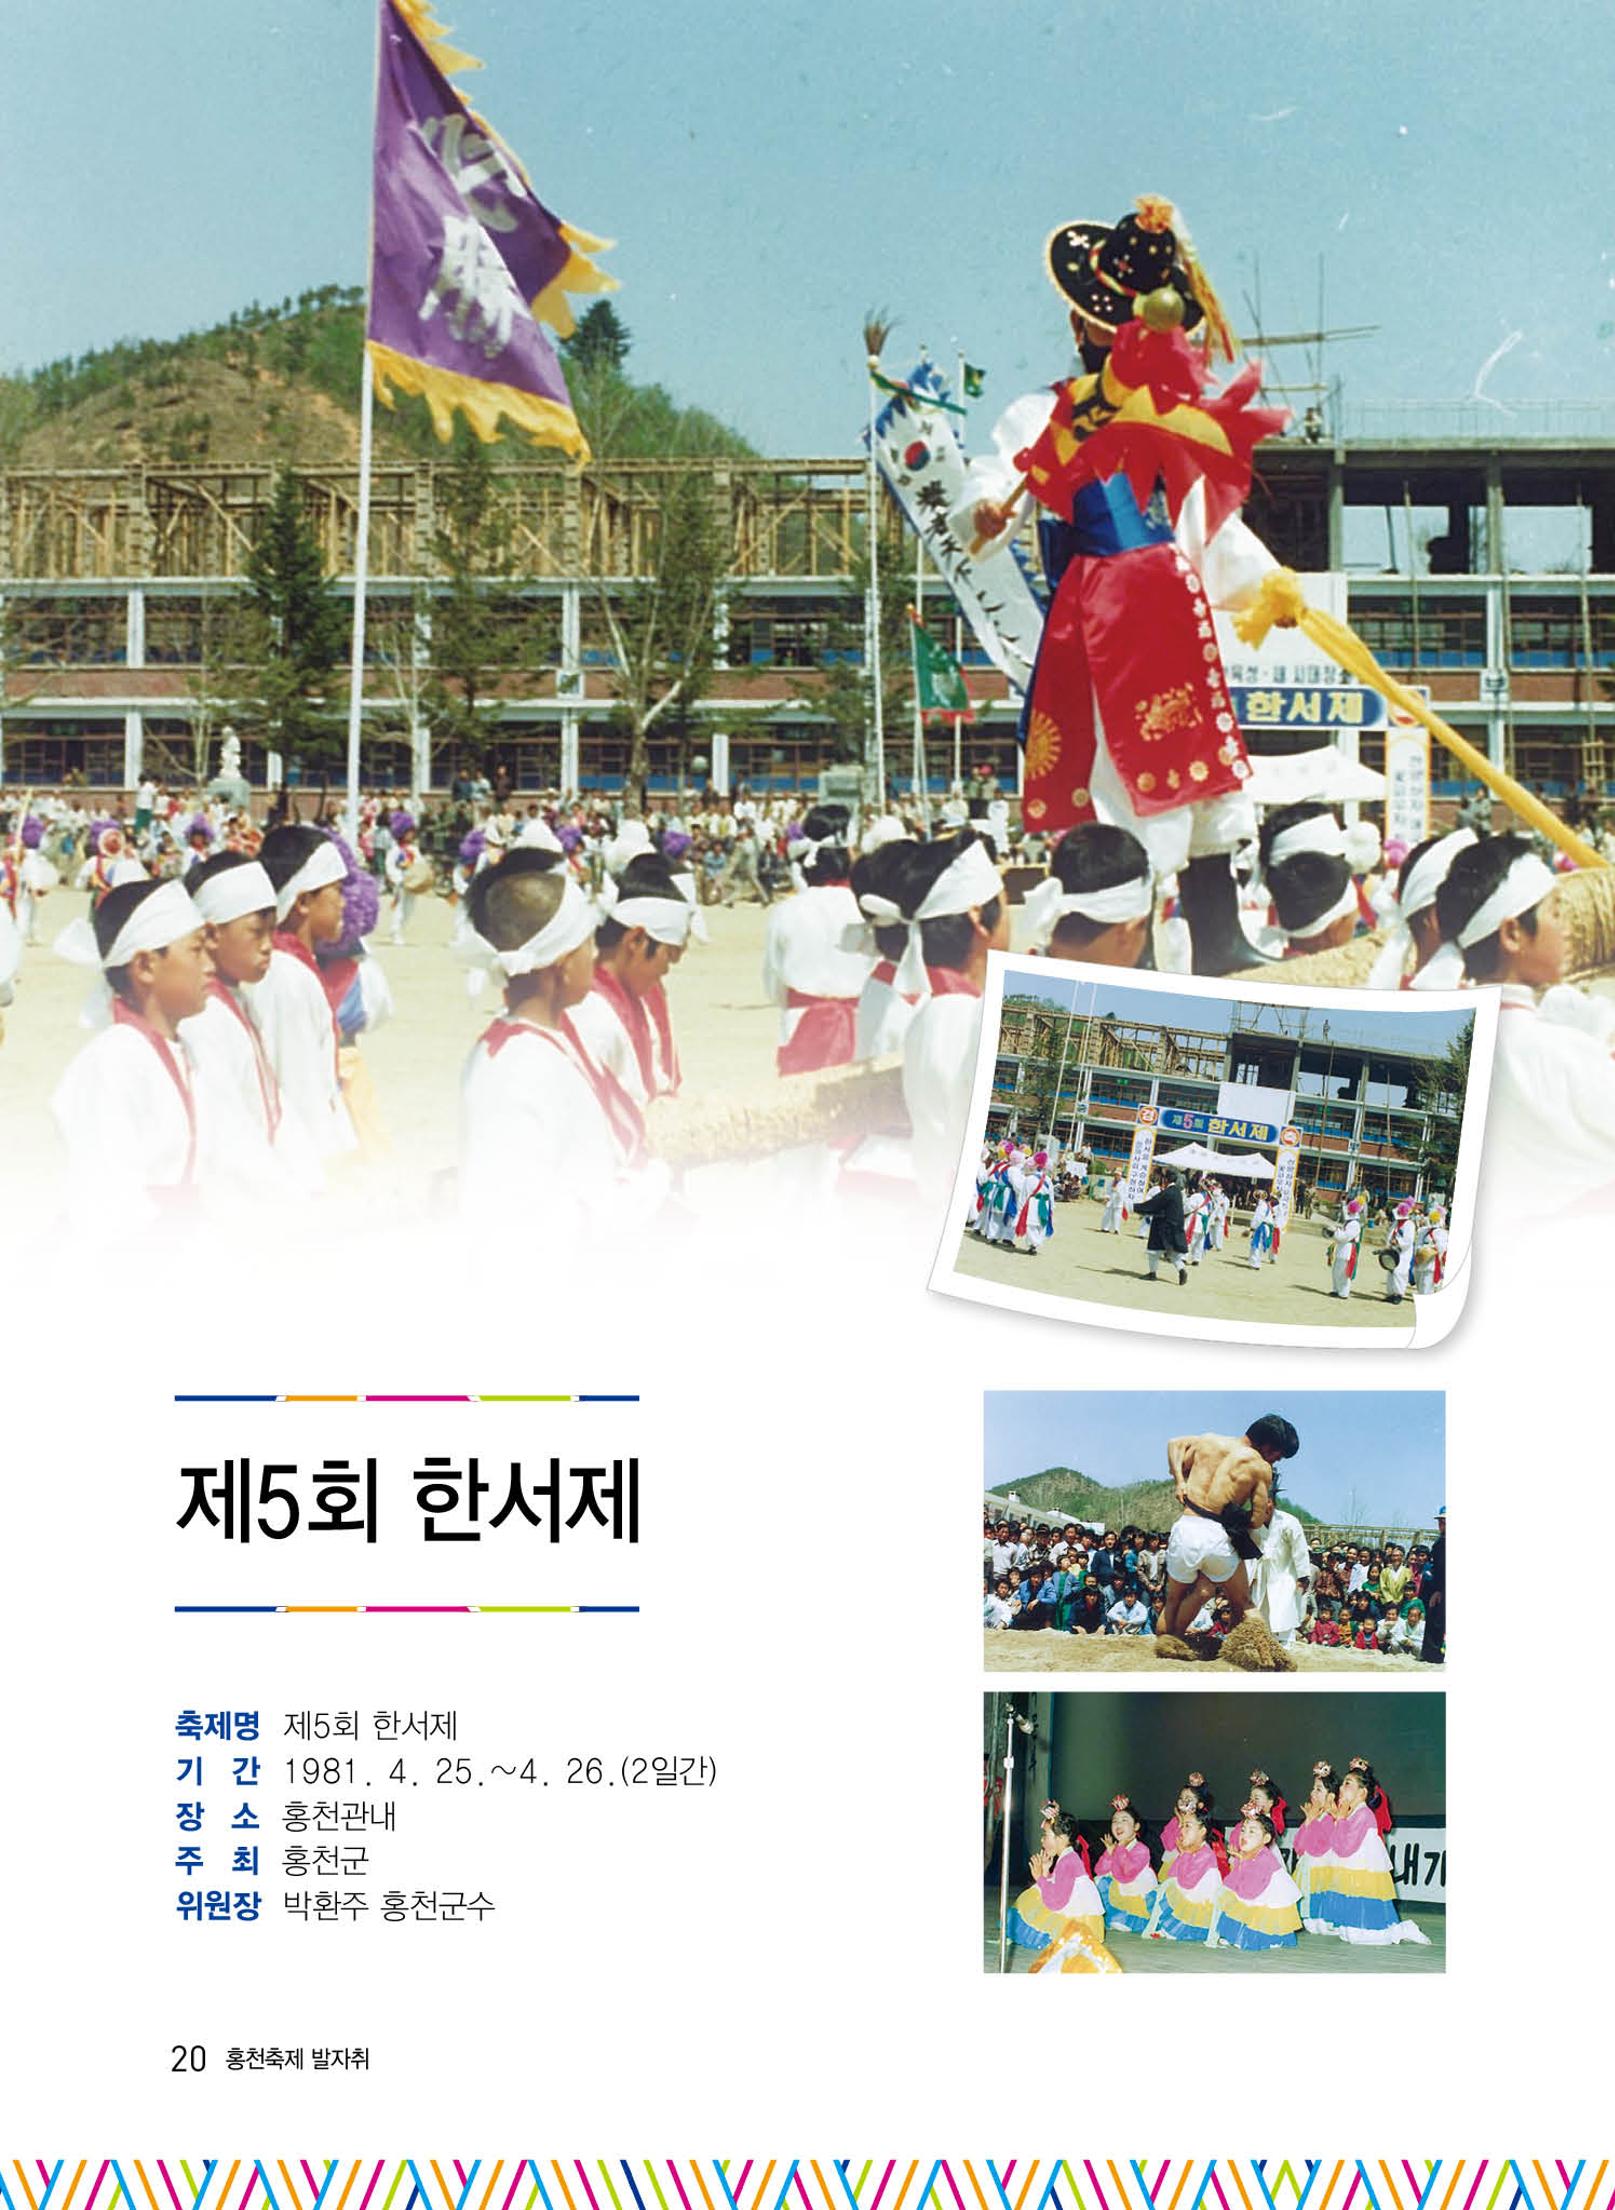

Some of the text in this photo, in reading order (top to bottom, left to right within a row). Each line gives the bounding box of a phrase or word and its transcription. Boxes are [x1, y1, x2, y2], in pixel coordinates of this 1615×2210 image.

[1246, 690, 1364, 724] 한서제
[1172, 1112, 1269, 1141] 제5회 한서제
[175, 1456, 640, 1544] 제5회 한서제
[175, 1709, 457, 1742] 축제명 제5회 한서제
[175, 1755, 203, 1787] 기
[231, 1755, 262, 1787] 간
[285, 1756, 372, 1787] 1981.
[388, 1756, 418, 1787] 4.
[566, 1755, 717, 1788] 26.(2일간)
[175, 1800, 396, 1833] 장 소 홍천관내
[174, 1844, 370, 1877] 주 최 홍천군
[175, 1889, 496, 1923] 위원장 박환주 홍천군수
[170, 2044, 369, 2073] 20 홍천축제 발자취
